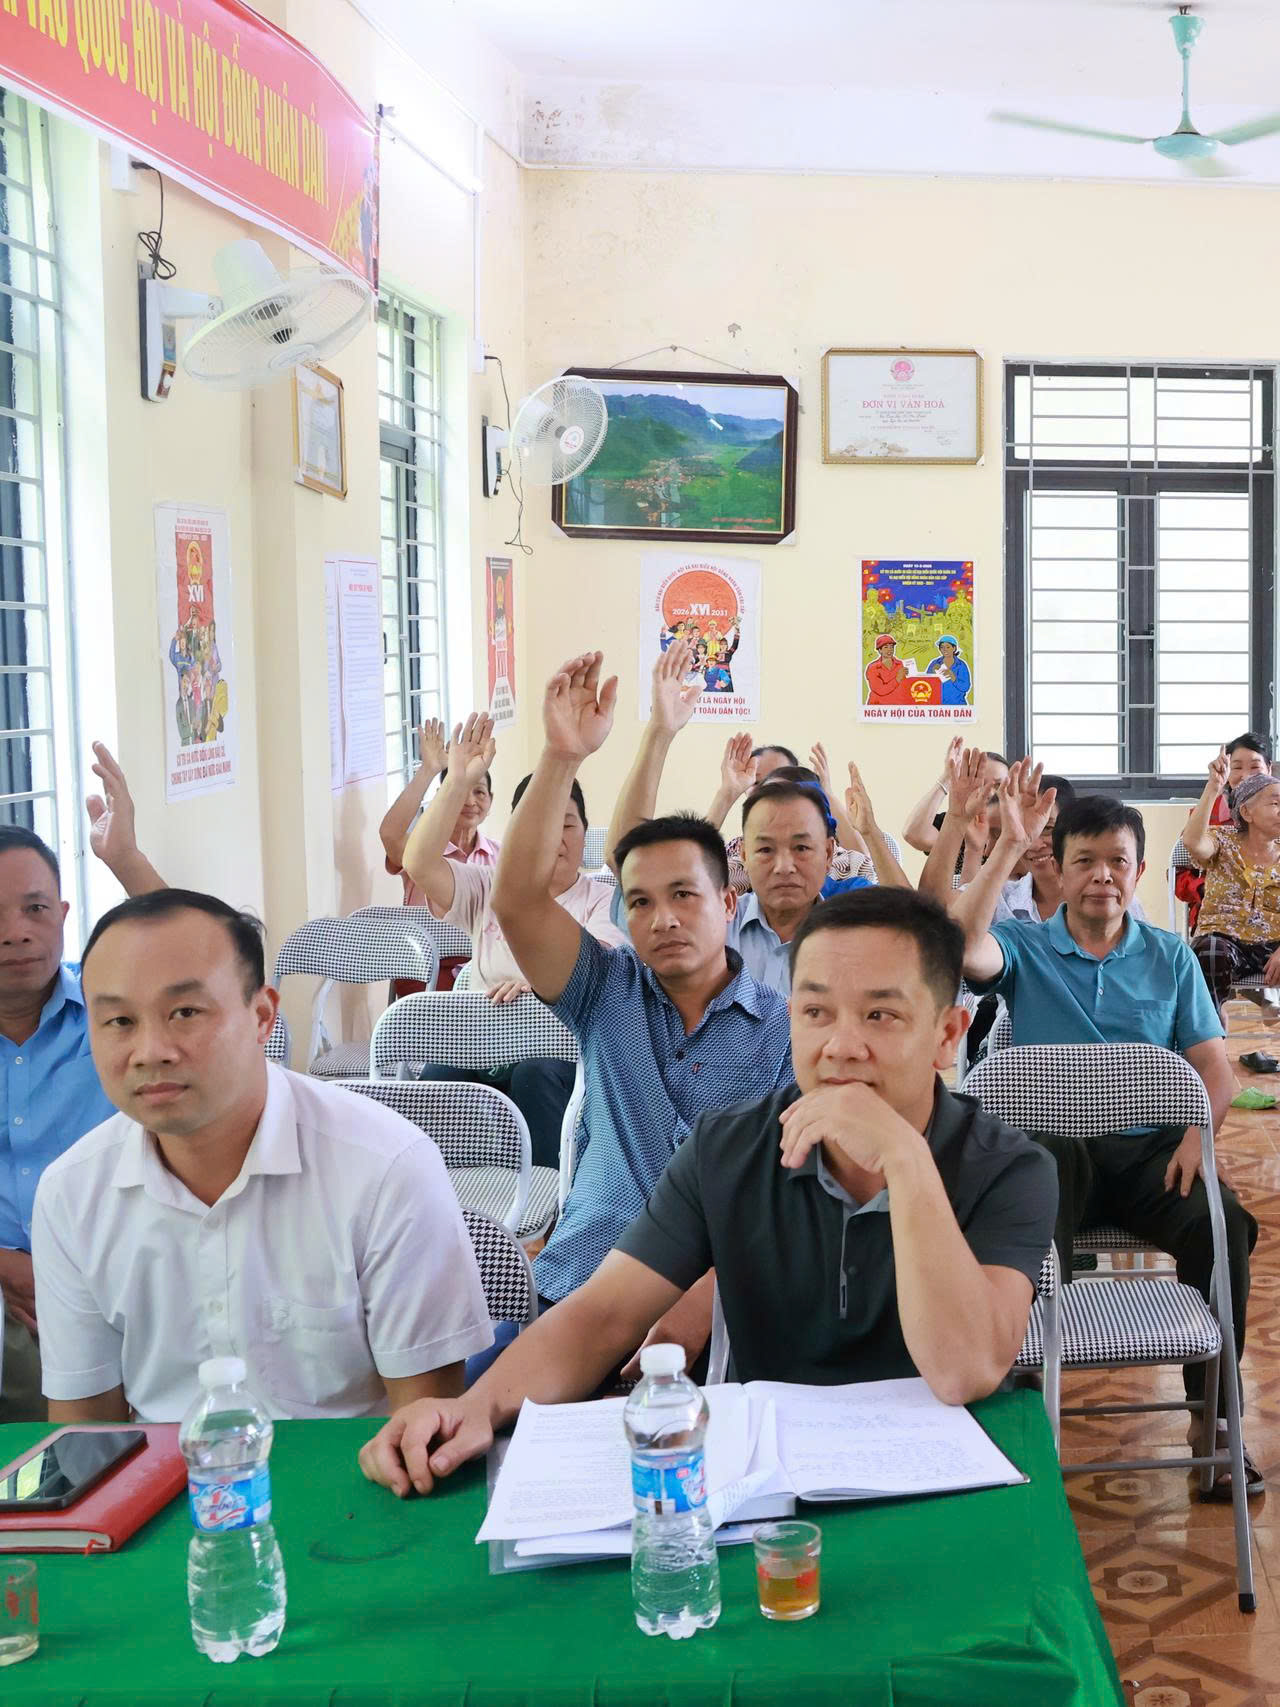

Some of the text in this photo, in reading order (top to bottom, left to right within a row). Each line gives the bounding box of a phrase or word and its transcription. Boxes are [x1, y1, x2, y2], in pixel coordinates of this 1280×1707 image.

[165, 0, 190, 123] VÀ
[191, 20, 220, 159] HỘI
[263, 81, 300, 191] NHÂN
[301, 101, 329, 211] DÂN
[187, 584, 204, 602] XVI
[690, 603, 711, 616] XVI
[864, 708, 888, 717] NGÀY
[890, 708, 905, 719] HỘI
[907, 706, 925, 717] CỦA
[928, 708, 951, 717] TOÀN
